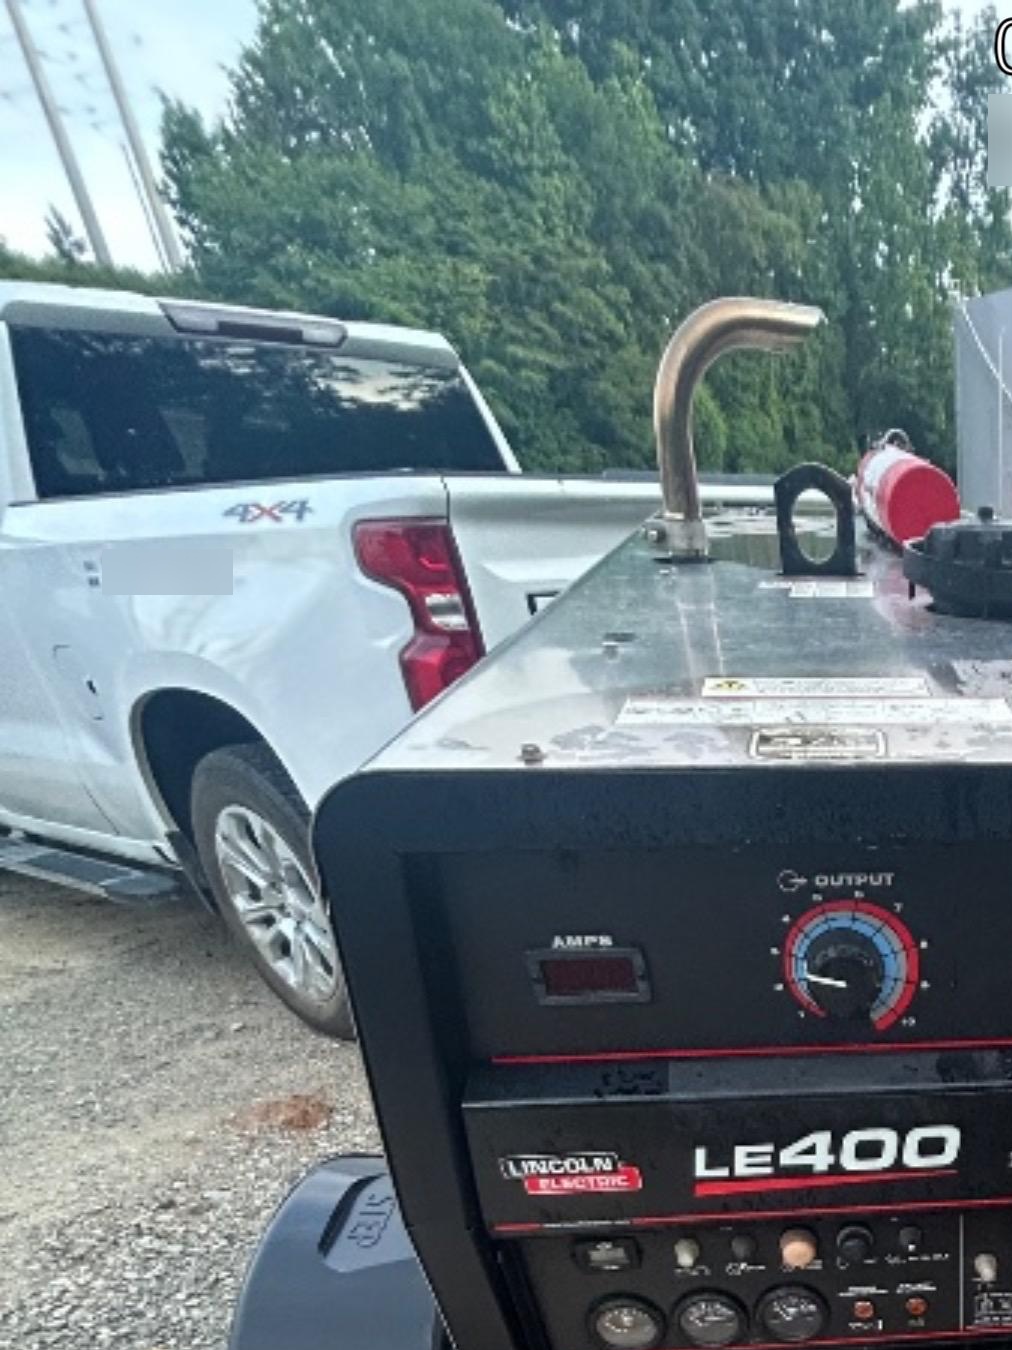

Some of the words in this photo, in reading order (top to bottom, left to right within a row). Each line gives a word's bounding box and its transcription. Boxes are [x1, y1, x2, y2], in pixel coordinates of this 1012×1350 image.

[815, 873, 894, 886] OUTPUT
[551, 934, 614, 949] AMPS
[695, 1125, 962, 1178] LE400
[508, 1157, 613, 1178] LINCOLN
[538, 1175, 632, 1190] ELECTRIC
